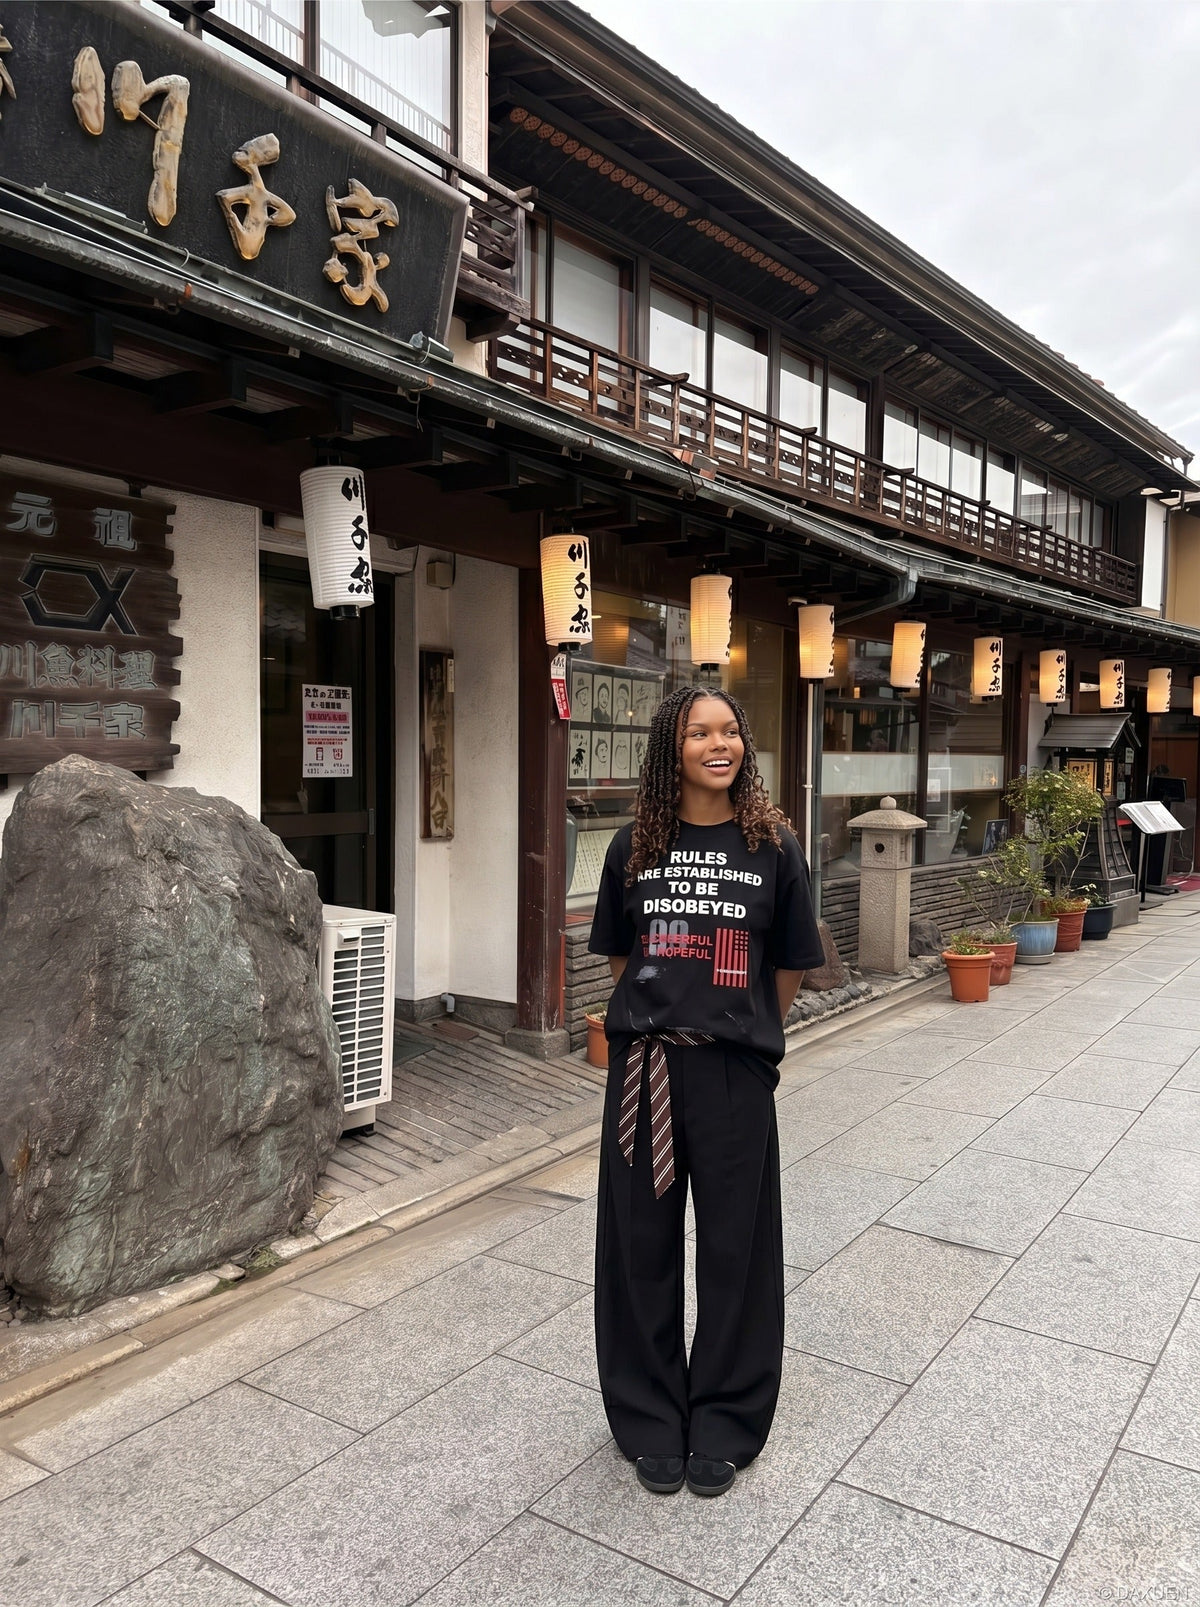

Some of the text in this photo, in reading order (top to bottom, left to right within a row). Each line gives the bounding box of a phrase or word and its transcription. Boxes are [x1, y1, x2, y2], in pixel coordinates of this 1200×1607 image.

[5, 492, 137, 550] 元祖
[0, 640, 158, 690] 川魚料理
[9, 700, 147, 739] 川千家
[670, 850, 728, 866] RULES
[637, 866, 763, 887] ARE ESTABLISHED
[668, 881, 719, 896] TO BE
[643, 898, 747, 919] DISOBEYED
